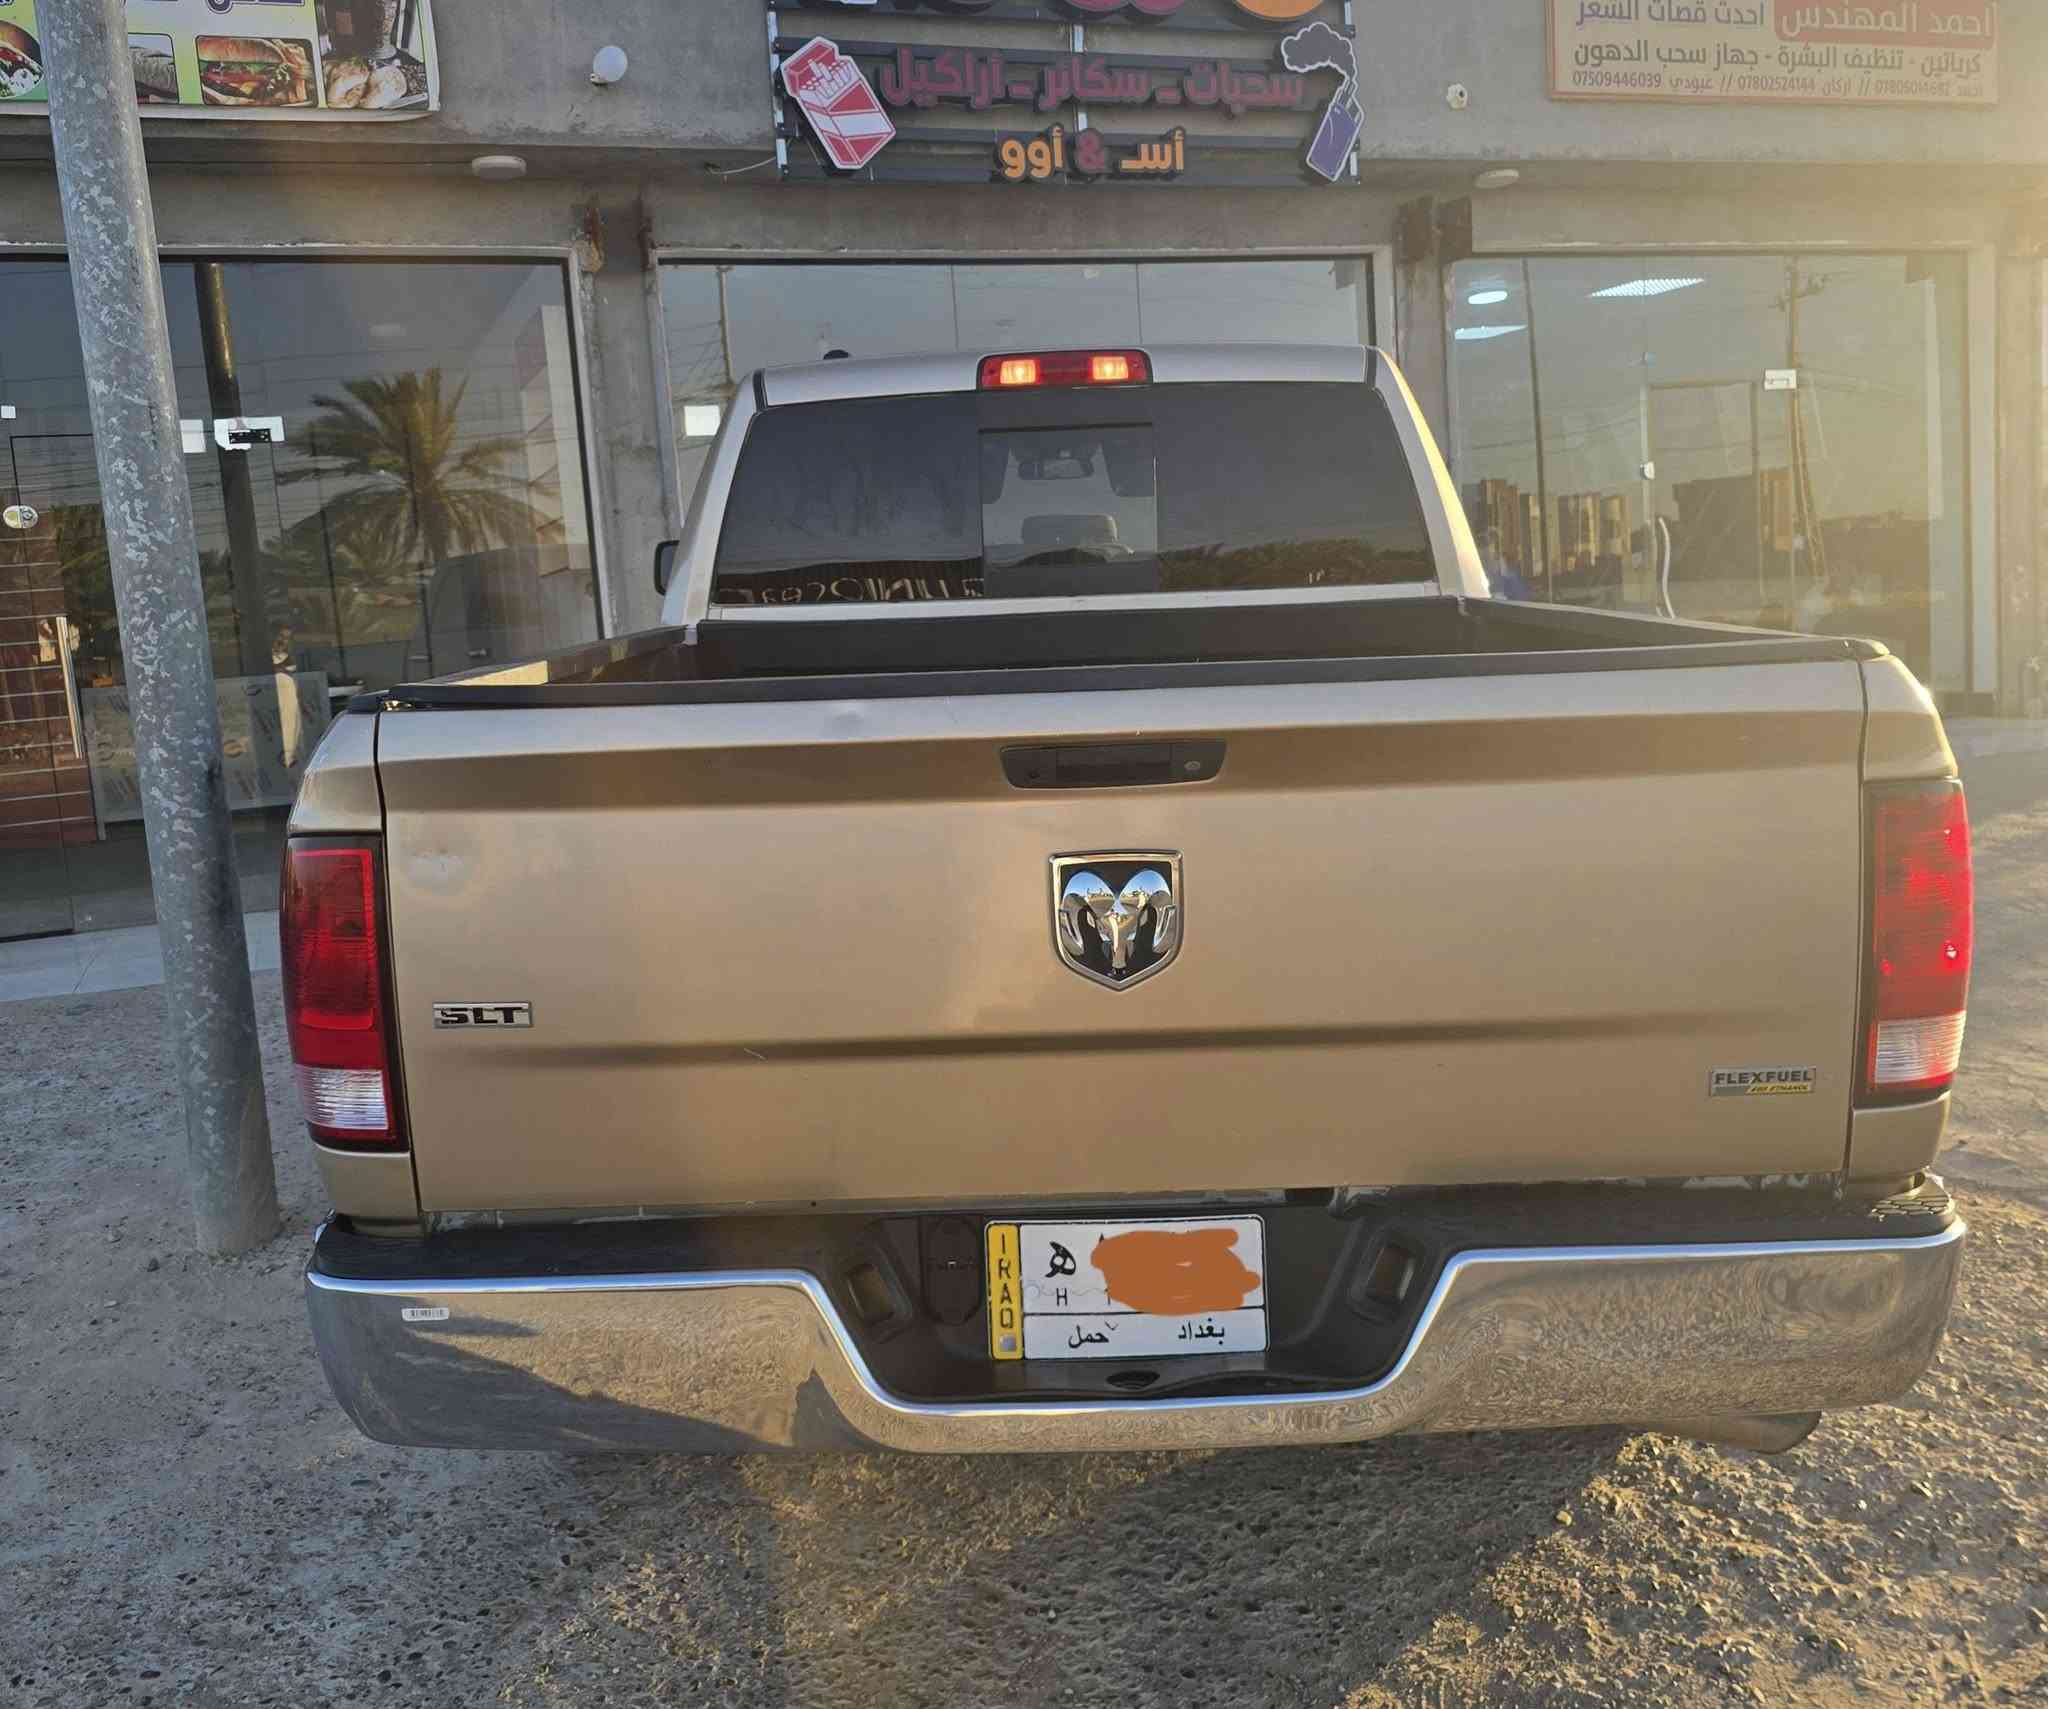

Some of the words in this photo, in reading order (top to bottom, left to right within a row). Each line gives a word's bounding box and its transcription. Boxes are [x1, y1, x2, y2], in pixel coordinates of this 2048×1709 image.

[1927, 4, 1992, 38] احمد
[1574, 40, 1649, 67] الدهون
[1655, 47, 1707, 68] سحب
[1712, 42, 1759, 71] جهاز
[1777, 45, 1838, 73] البشرة
[1844, 48, 1904, 74] تنظيف
[1572, 71, 1662, 88] 07509446039
[440, 1006, 523, 1024] SLT
[997, 1233, 1015, 1329] IRAQ
[1056, 1287, 1068, 1306] H
[1068, 1324, 1110, 1349] حمل
[1178, 1317, 1225, 1345] بغداد
